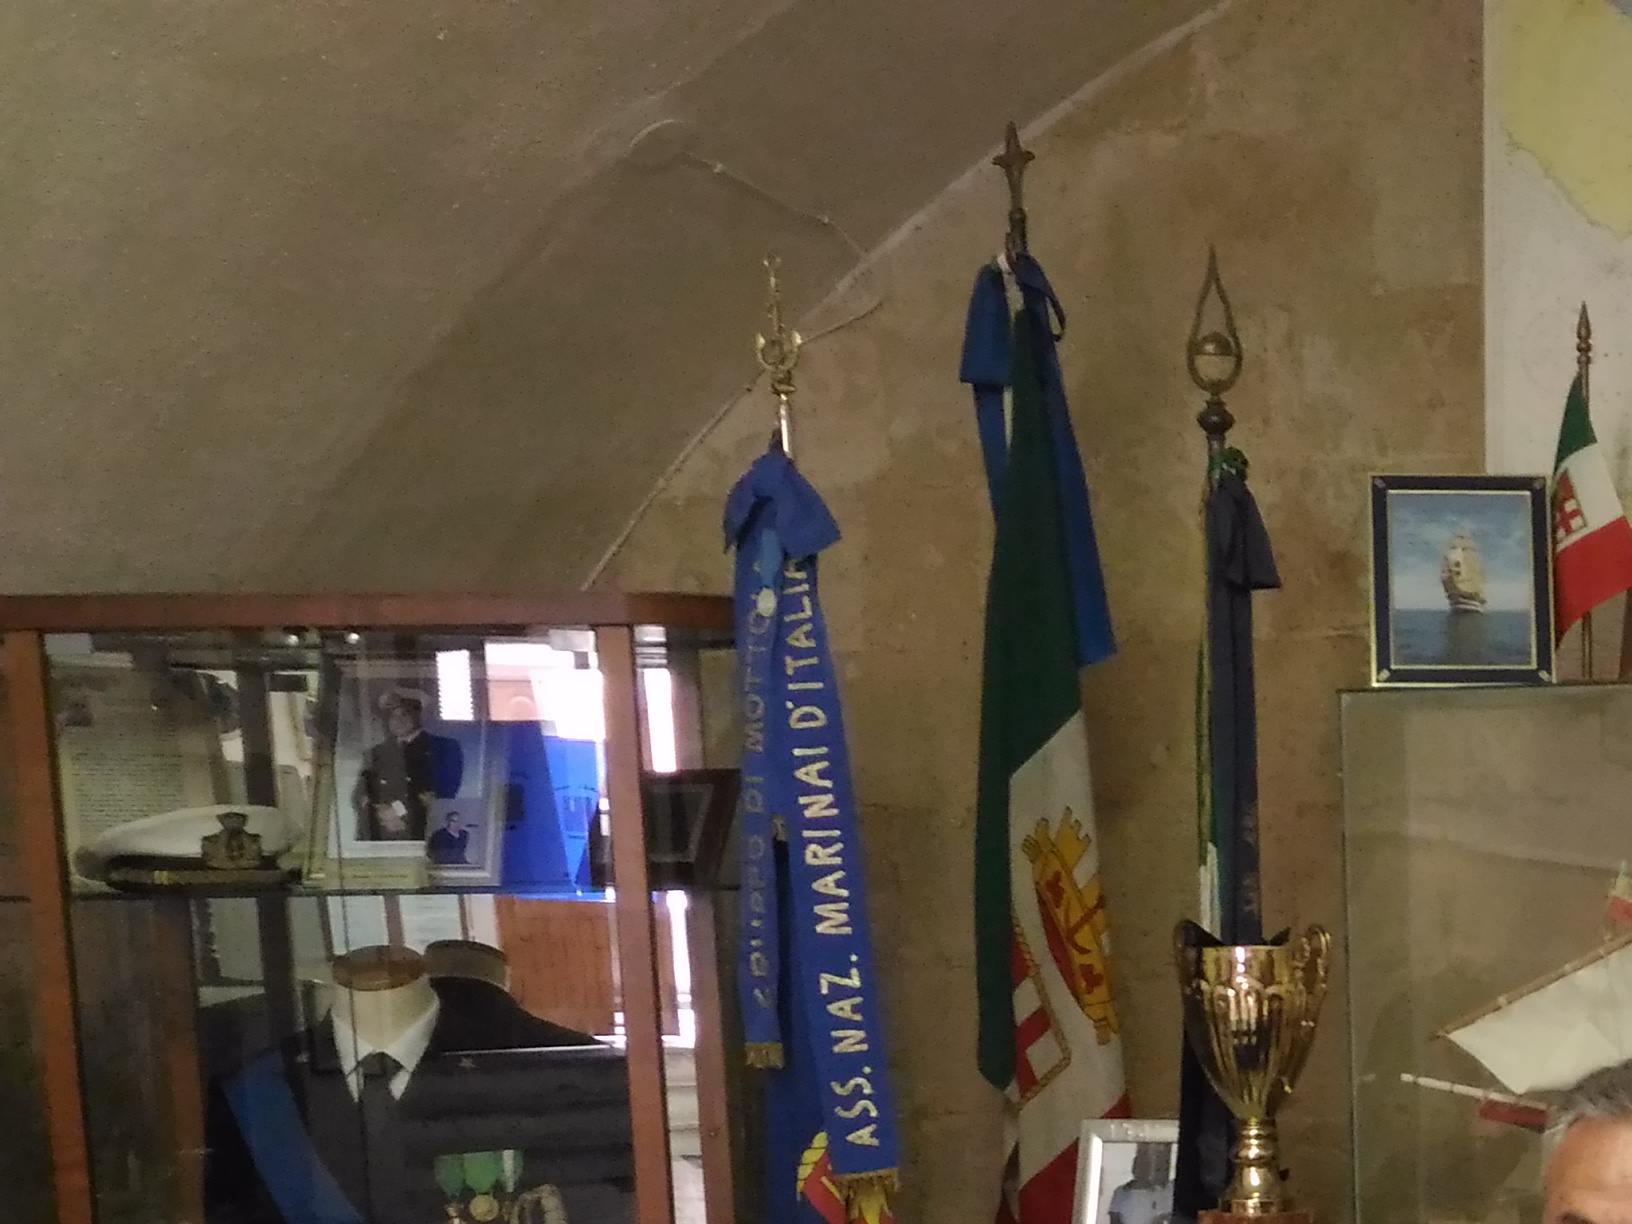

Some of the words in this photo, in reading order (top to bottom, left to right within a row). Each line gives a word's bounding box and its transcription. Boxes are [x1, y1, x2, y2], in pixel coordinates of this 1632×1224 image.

[745, 560, 776, 755] MOTTO
[792, 746, 852, 935] MARINAI
[819, 954, 870, 1054] NAZ.
[831, 1066, 880, 1147] ASS.
